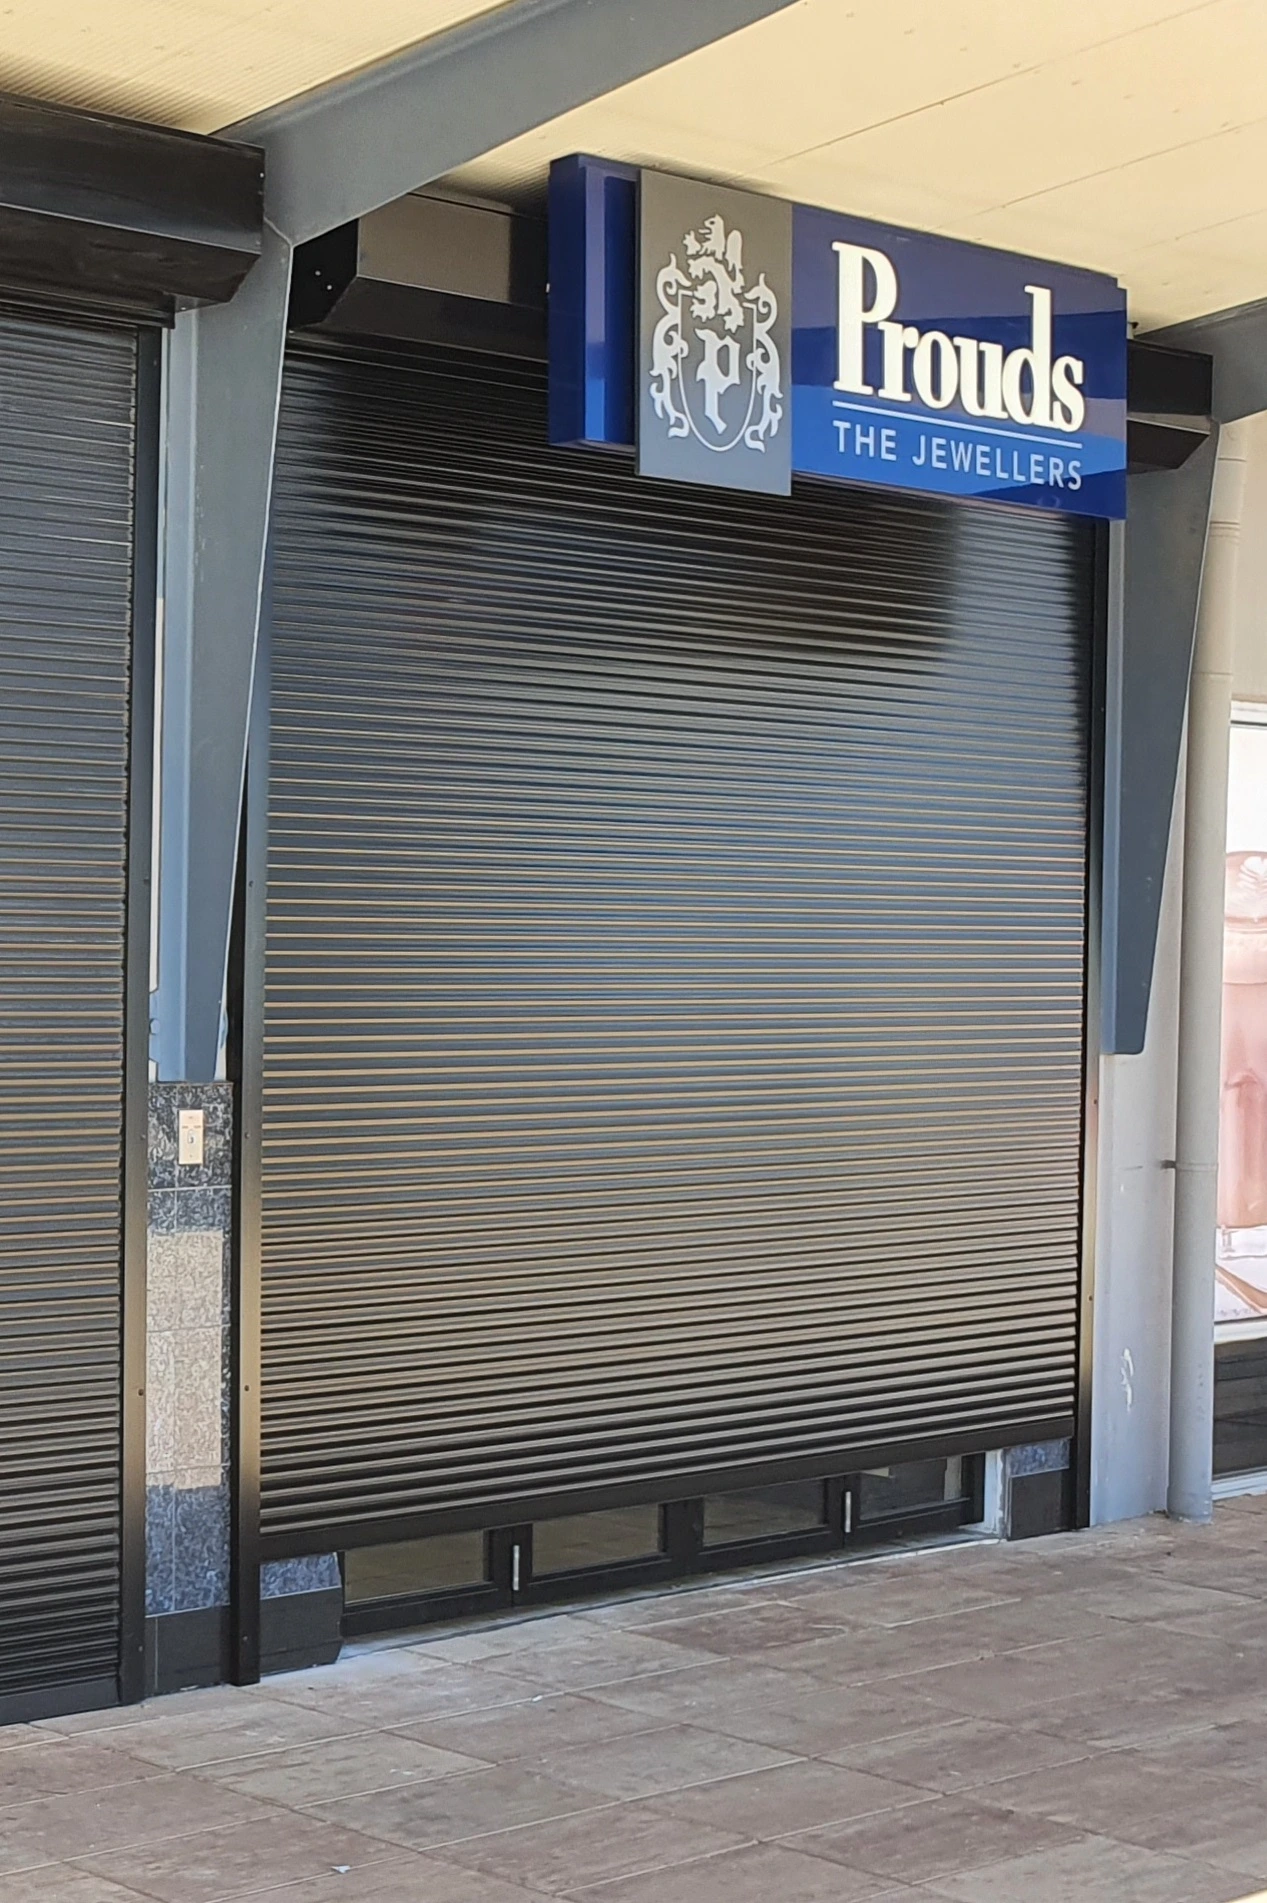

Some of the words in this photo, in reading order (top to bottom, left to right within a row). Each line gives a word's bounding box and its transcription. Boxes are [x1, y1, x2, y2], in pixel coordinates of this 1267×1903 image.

[831, 242, 1084, 431] Prouds
[832, 421, 897, 461] THE
[913, 435, 1082, 490] JEWELLERS
